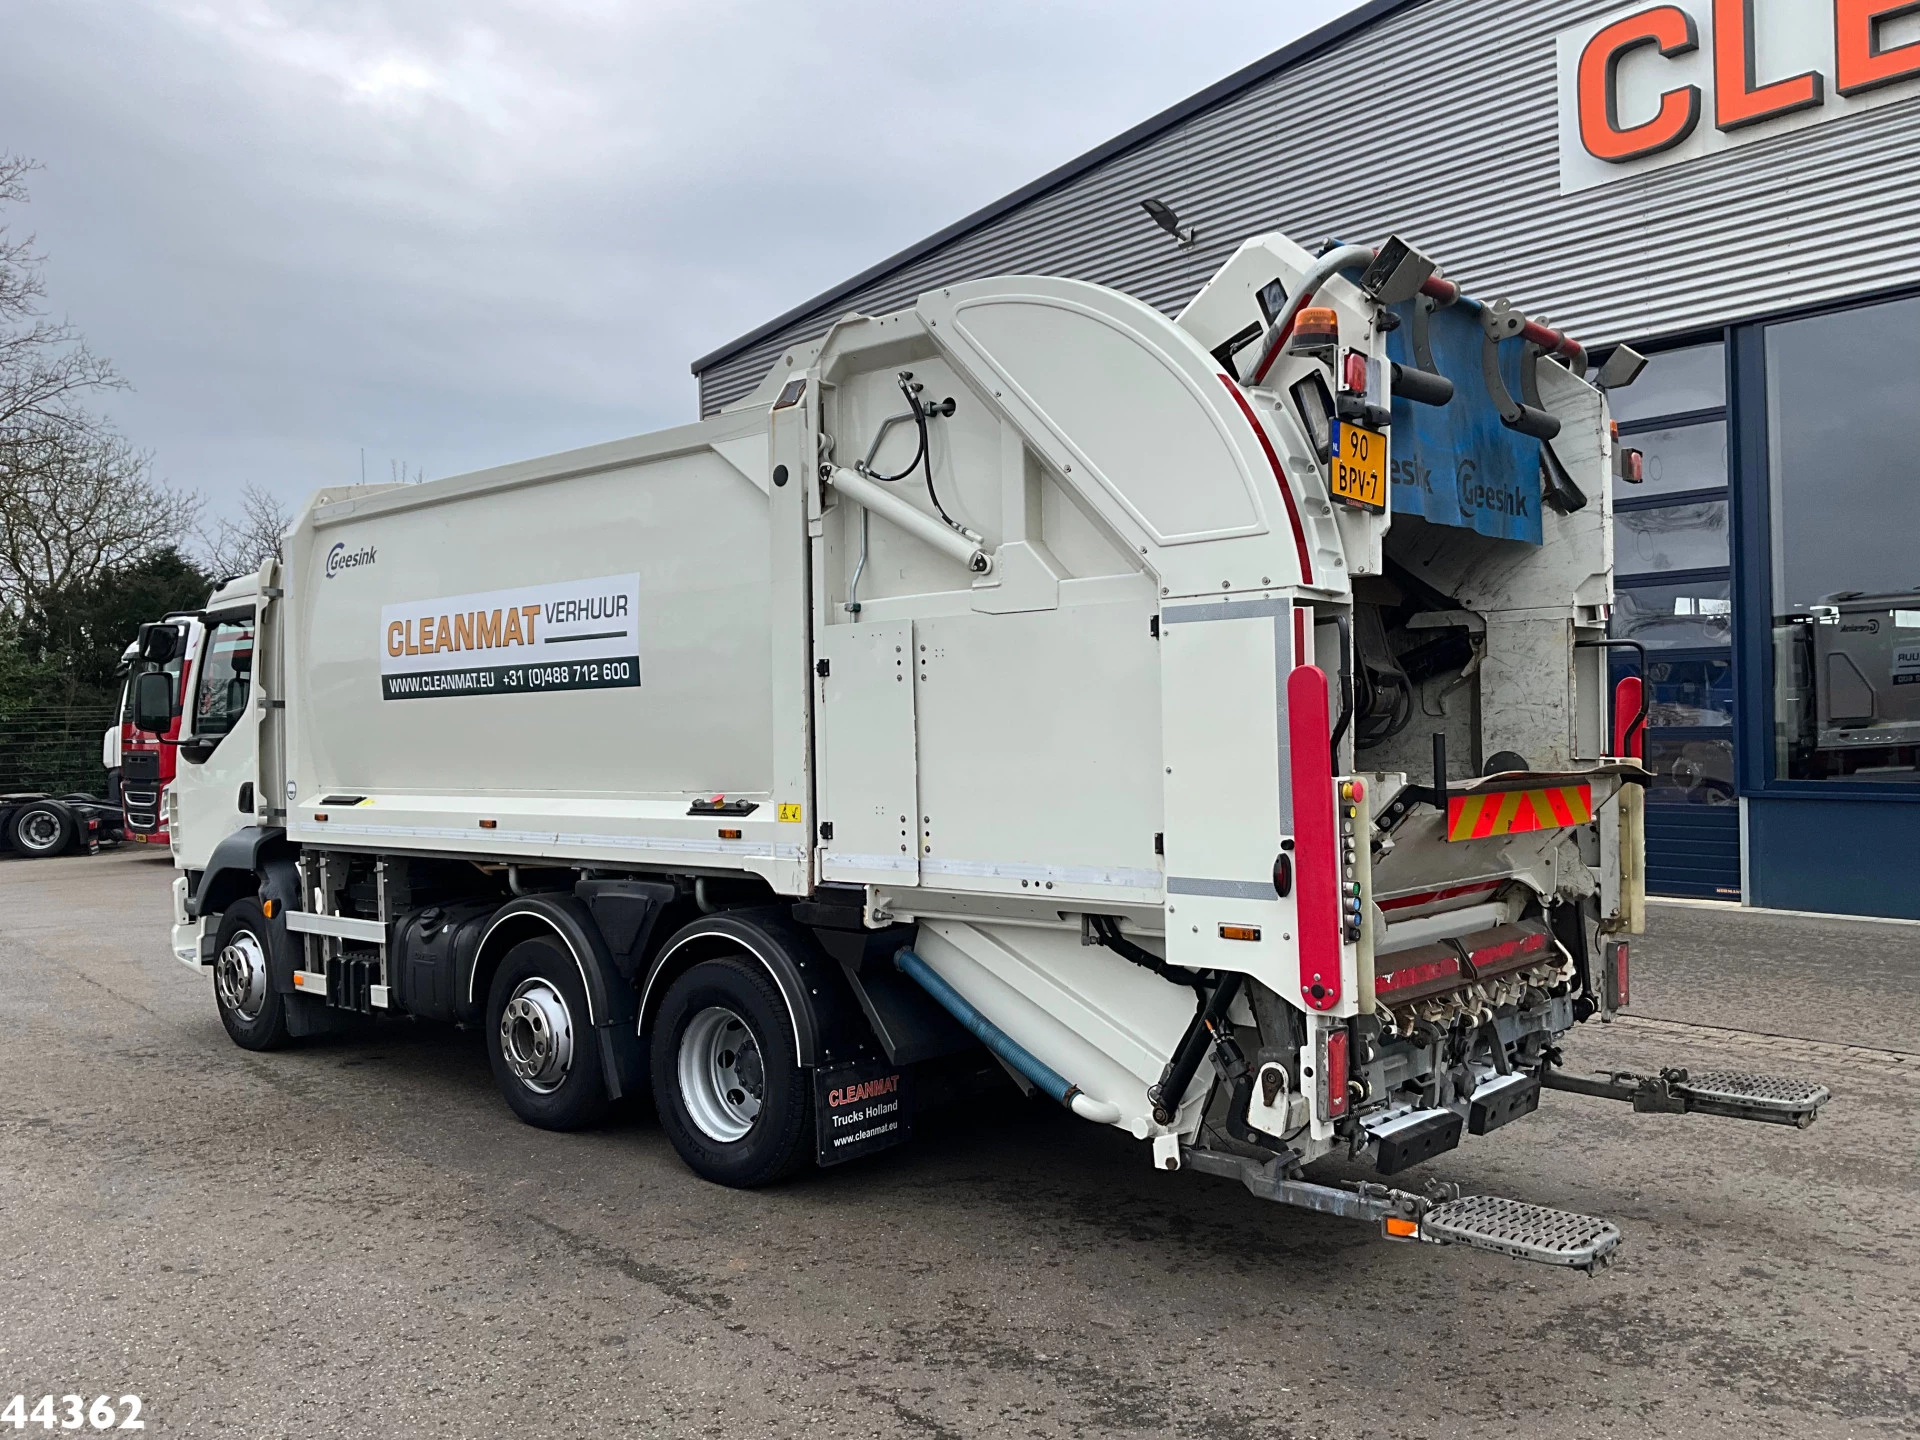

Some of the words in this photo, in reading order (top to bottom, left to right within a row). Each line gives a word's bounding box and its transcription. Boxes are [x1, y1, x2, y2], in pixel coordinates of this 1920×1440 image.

[1351, 431, 1368, 461] 90
[1339, 464, 1378, 499] BPV-7
[1459, 466, 1528, 517] Geesink
[328, 543, 377, 574] Geesink
[387, 605, 541, 657] CLEANMAT
[545, 594, 628, 624] VERHUUR
[389, 671, 495, 693] WWW.CLEANMAT.EU
[503, 669, 524, 686] +31
[528, 666, 569, 687] (0)488
[573, 664, 599, 681] 712
[603, 662, 630, 680] 600
[829, 1075, 899, 1107] CLEANMAT
[832, 1111, 864, 1128] Trucks
[866, 1099, 898, 1119] Holland
[833, 1121, 898, 1147] www.cleanmat.eu
